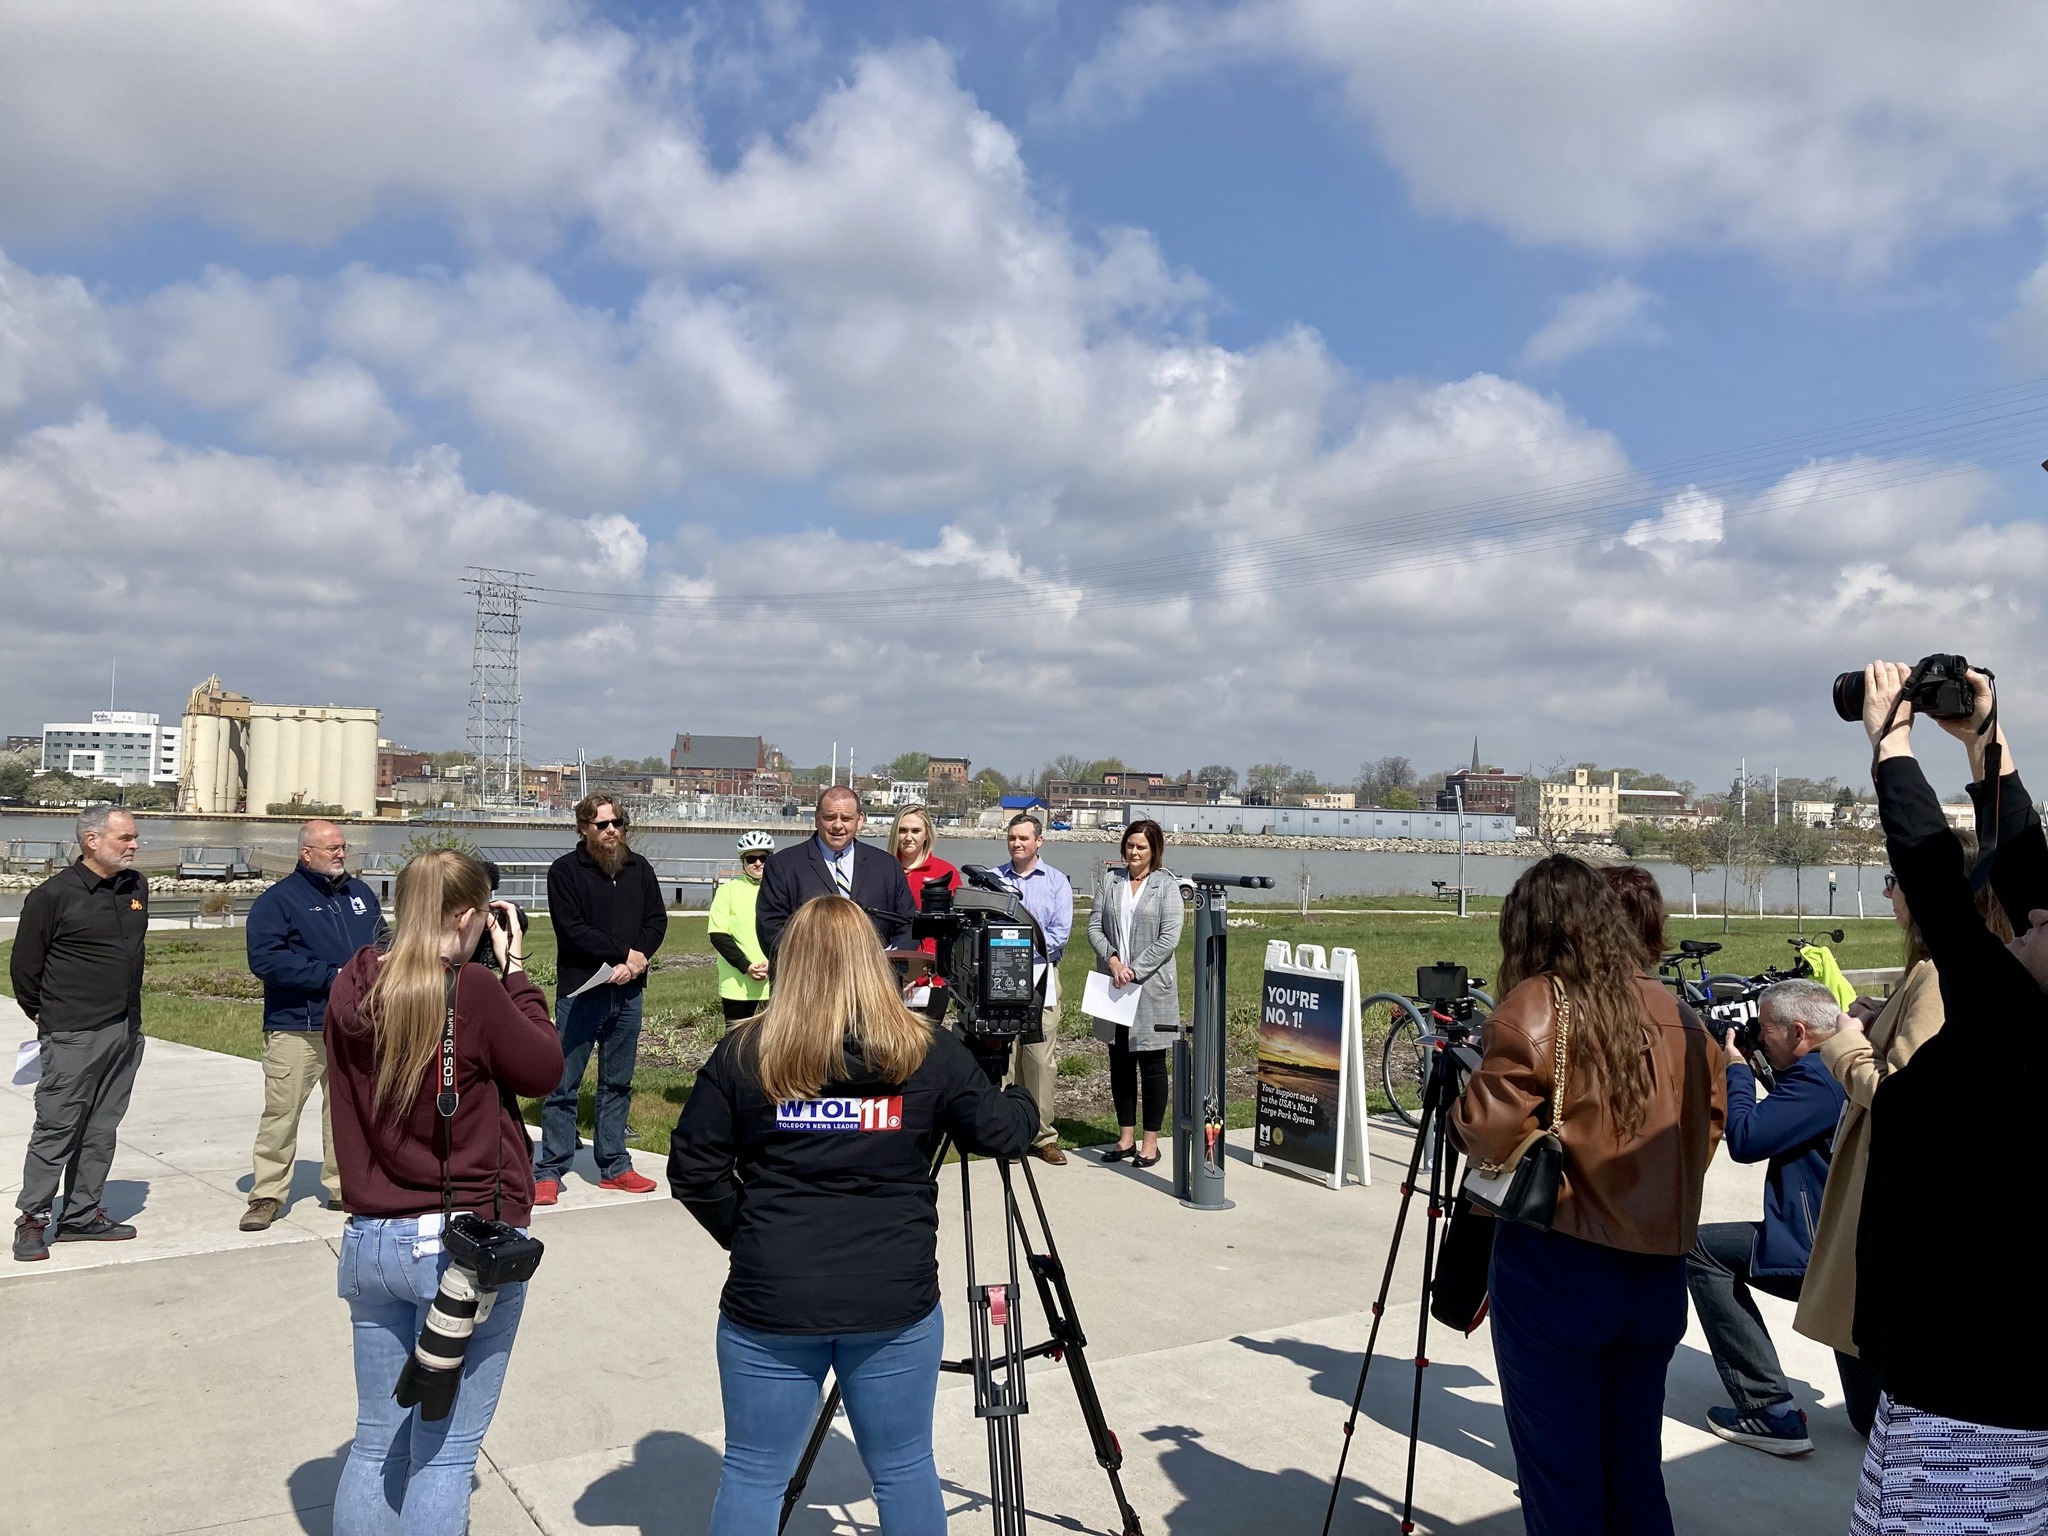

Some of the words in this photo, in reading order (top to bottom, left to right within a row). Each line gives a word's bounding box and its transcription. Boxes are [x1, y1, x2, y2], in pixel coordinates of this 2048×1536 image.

[1267, 986, 1320, 1010] YOU'RE
[447, 1007, 454, 1016] IV
[1265, 1006, 1289, 1026] NO.
[1292, 1011, 1303, 1029] 1!
[443, 1038, 454, 1054] 5D
[443, 1056, 453, 1086] EOS
[1262, 1083, 1274, 1093] Your
[1275, 1088, 1299, 1100] support
[1299, 1094, 1318, 1104] made
[1268, 1095, 1279, 1105] the
[1278, 1098, 1297, 1110] USA's
[1297, 1102, 1308, 1113] No.
[1308, 1105, 1313, 1114] 1
[780, 1100, 859, 1118] WTOL
[860, 1098, 889, 1129] 11
[1260, 1104, 1277, 1117] Large
[1277, 1108, 1292, 1120] Park
[1291, 1112, 1315, 1126] System
